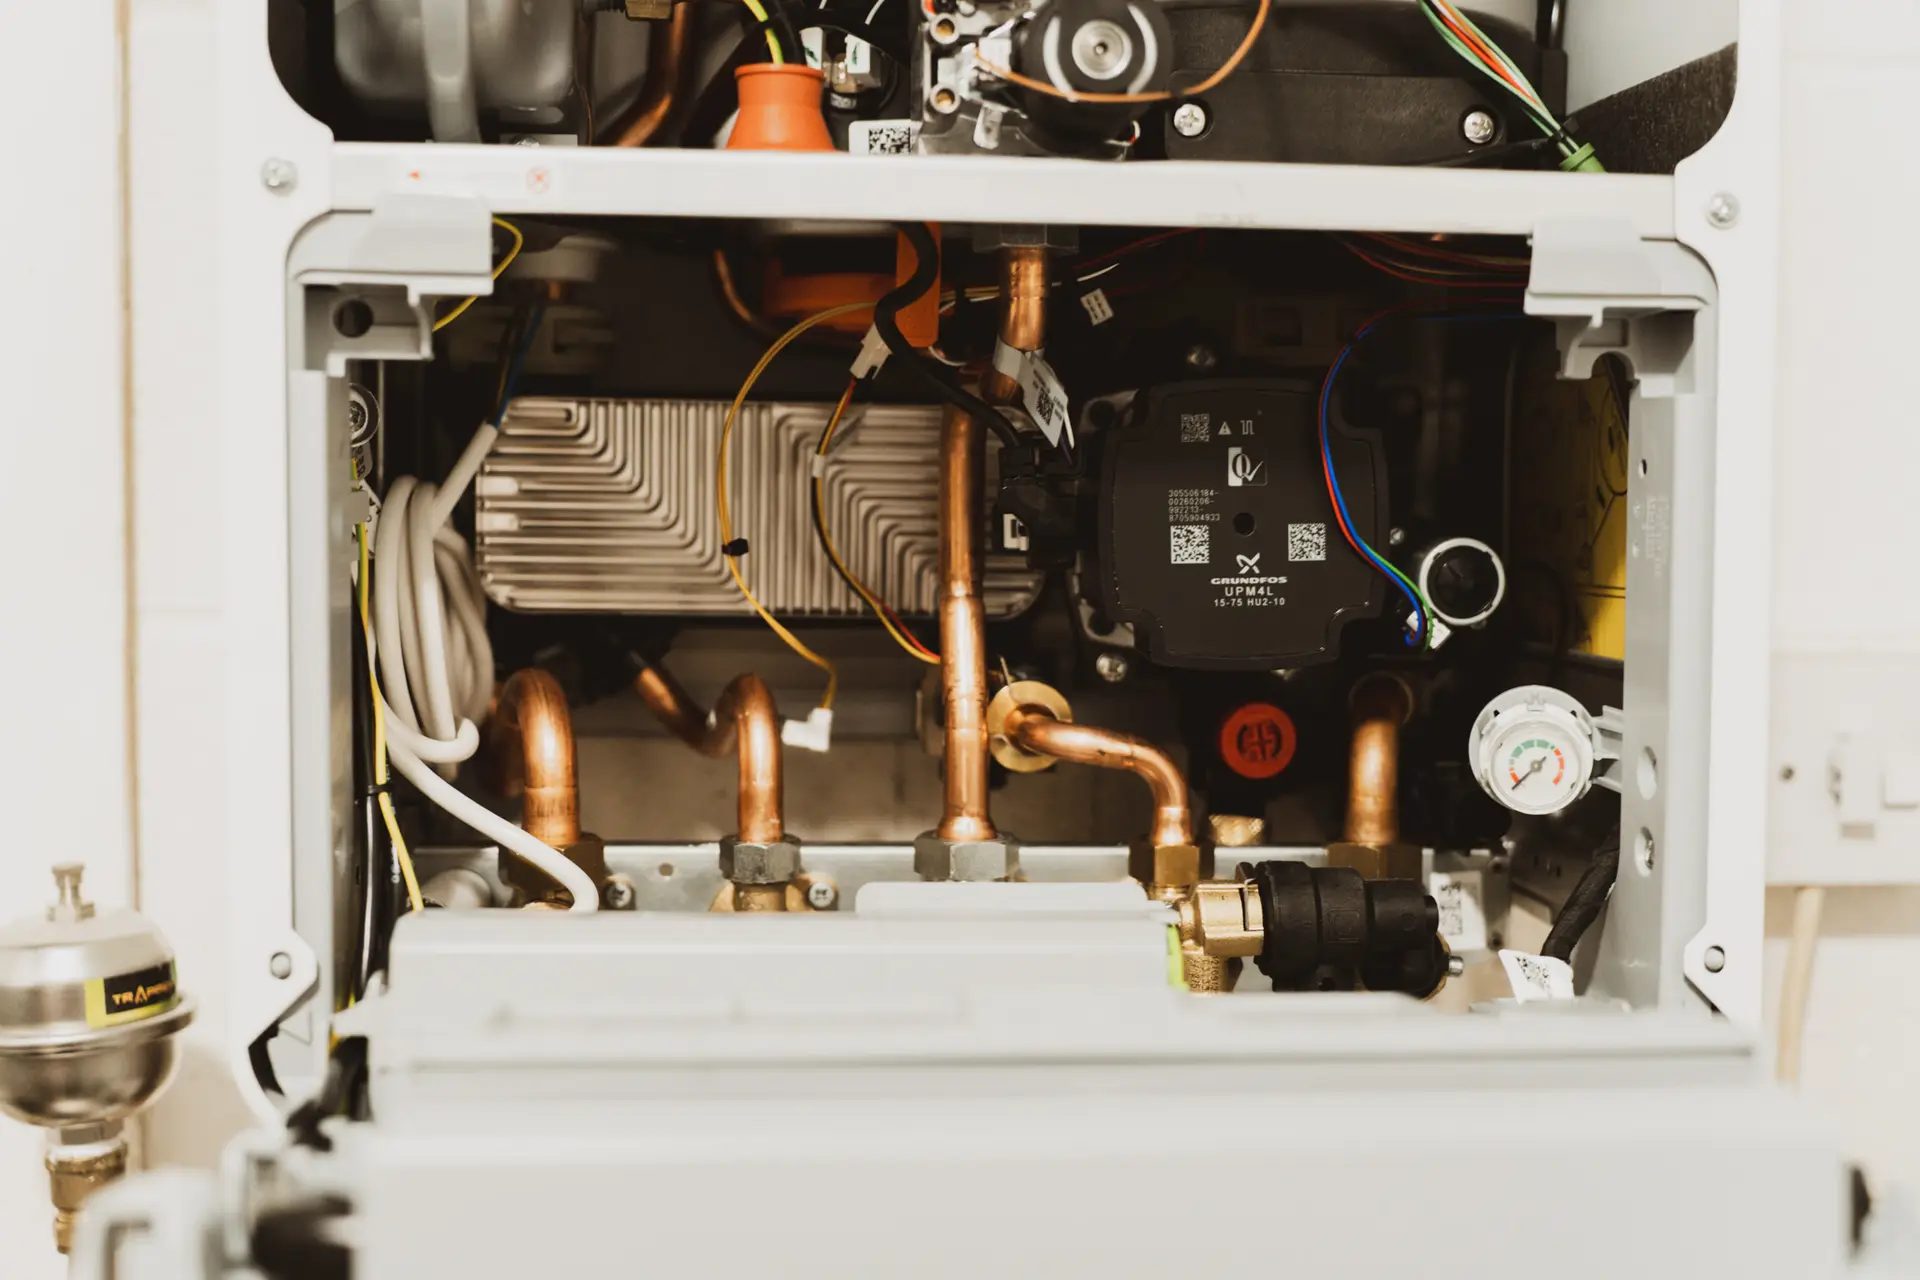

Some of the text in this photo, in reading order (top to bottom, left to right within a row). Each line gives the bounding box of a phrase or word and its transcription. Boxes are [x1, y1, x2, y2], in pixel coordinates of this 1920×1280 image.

[1211, 577, 1288, 585] GRUNDFOS
[1224, 586, 1274, 596] UPM4L
[1214, 597, 1286, 607] 15-75 HU2-10
